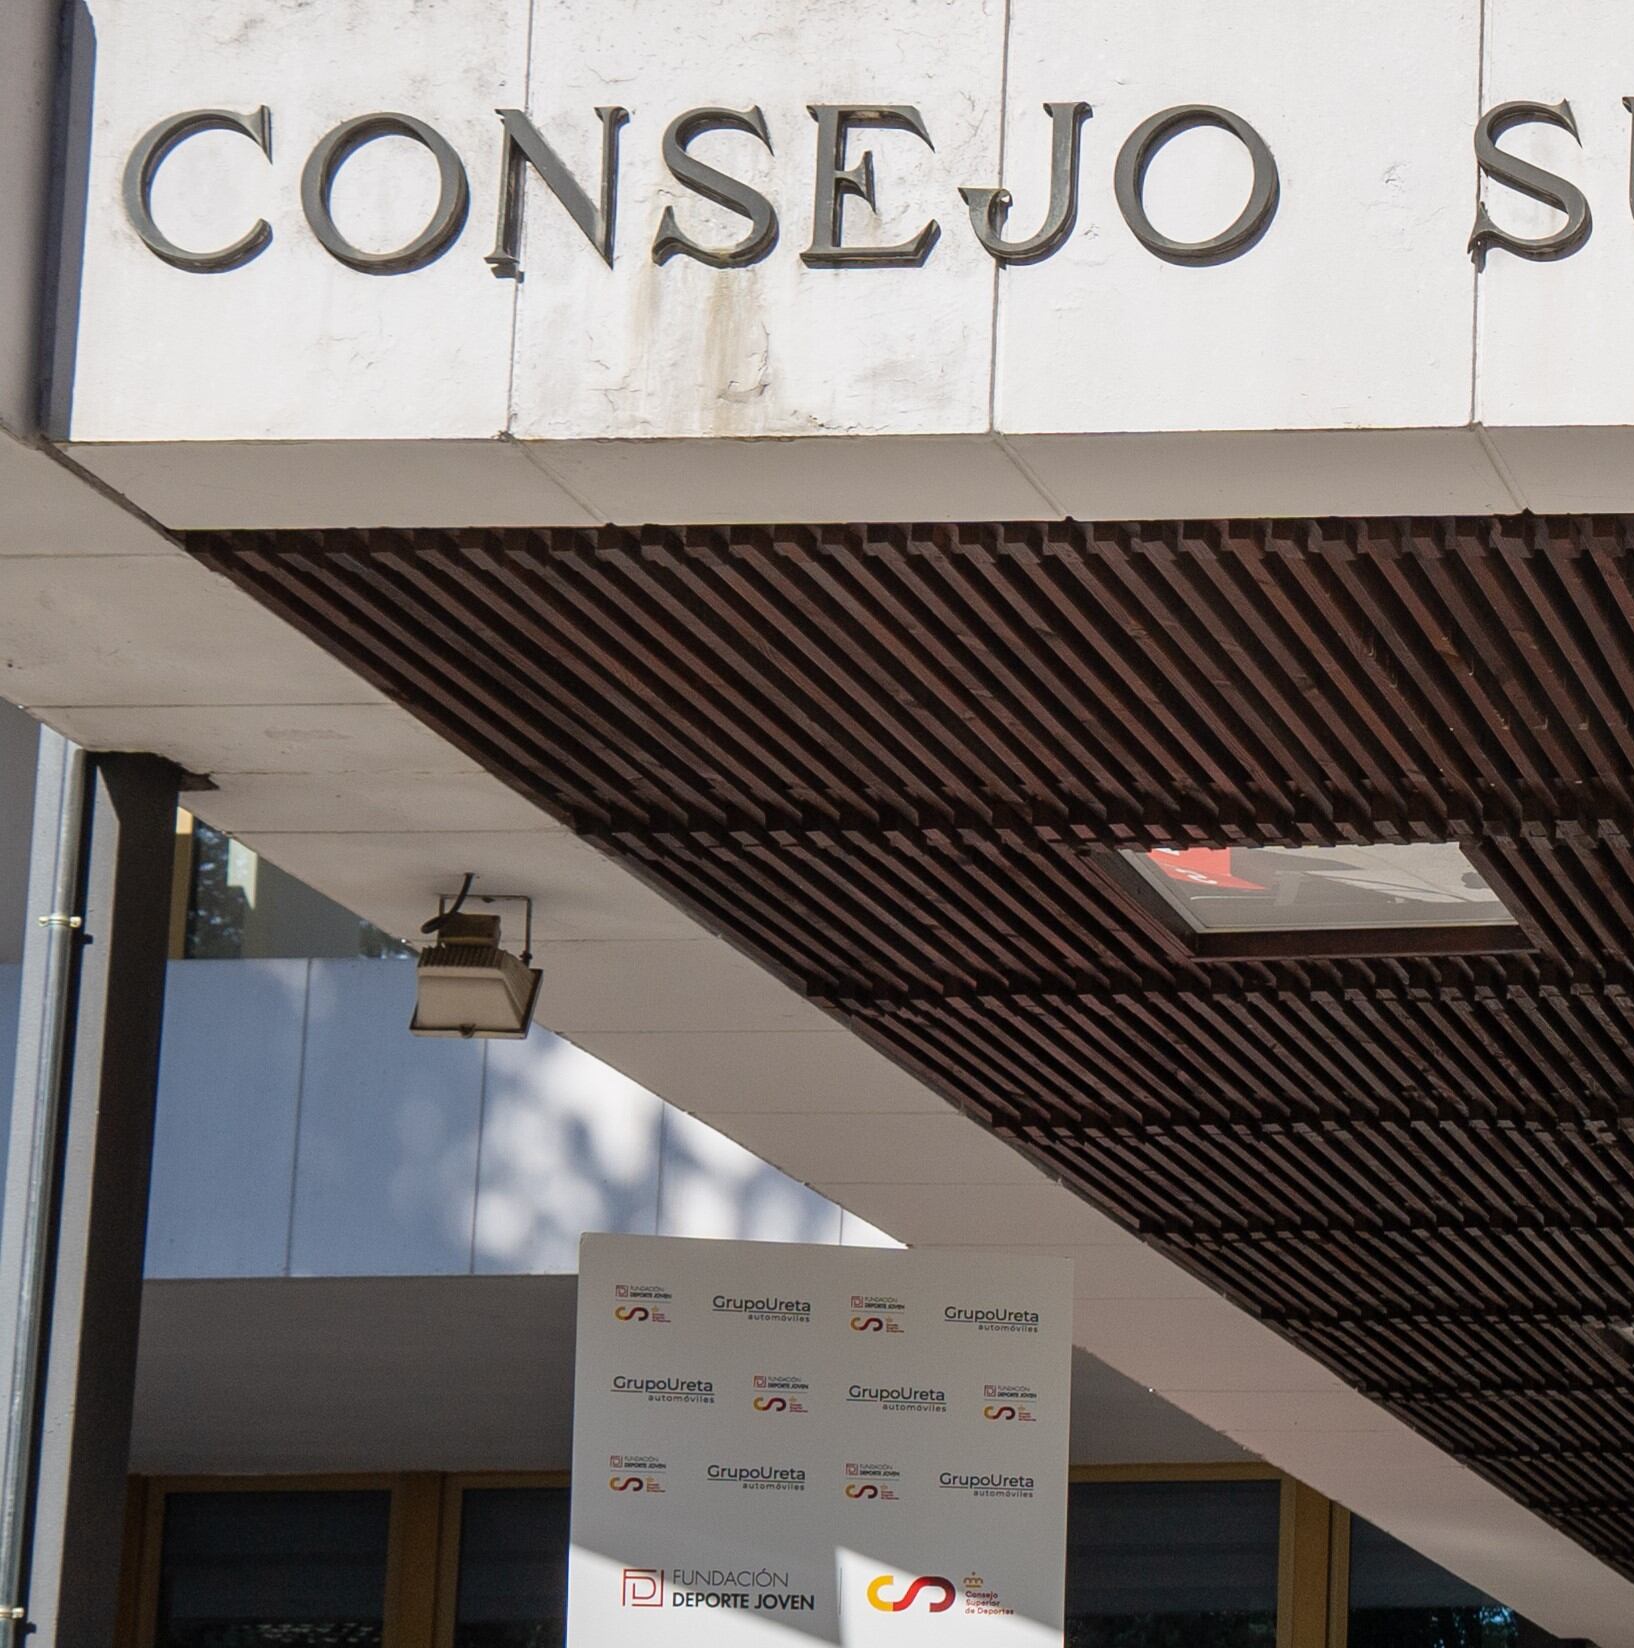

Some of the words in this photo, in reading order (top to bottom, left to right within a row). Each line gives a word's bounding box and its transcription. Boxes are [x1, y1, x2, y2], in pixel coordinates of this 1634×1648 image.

[122, 102, 1279, 274] CONSEJO
[713, 1295, 810, 1313] GrupoUreta
[748, 1314, 810, 1322] automóviles
[944, 1306, 1039, 1322] GrupoUreta
[978, 1325, 1038, 1333] automóviles
[613, 1376, 713, 1394] GrupoUreta
[648, 1395, 714, 1404] automóviles
[849, 1385, 944, 1402] GrupoUreta
[882, 1404, 946, 1412] automóviles
[707, 1465, 805, 1481] GrupoUreta
[743, 1482, 804, 1491] automóviles
[939, 1473, 1034, 1490] GrupoUreta
[673, 1568, 788, 1587] FUNDACIÓN
[672, 1592, 749, 1609] DEPORTE
[754, 1594, 814, 1610] JOVEN
[965, 1590, 998, 1600] Consejo
